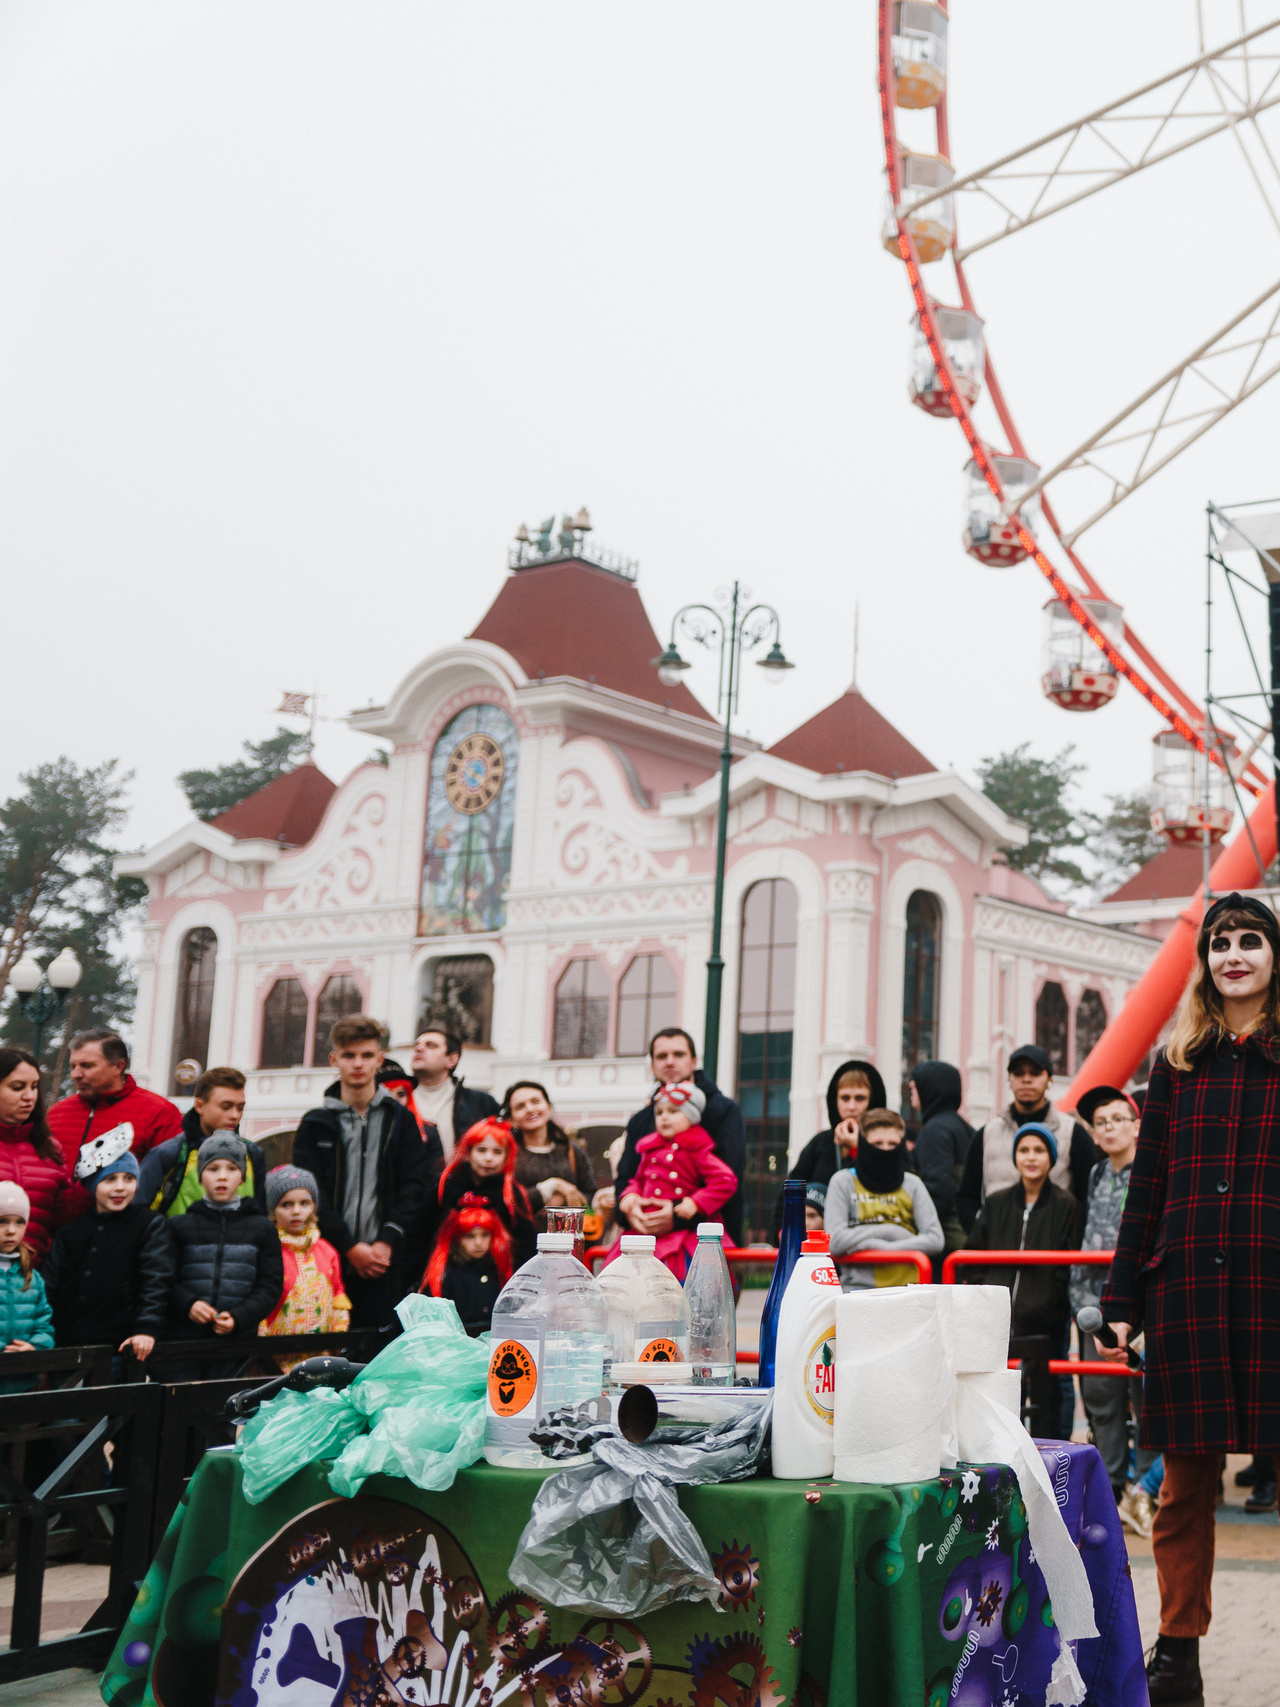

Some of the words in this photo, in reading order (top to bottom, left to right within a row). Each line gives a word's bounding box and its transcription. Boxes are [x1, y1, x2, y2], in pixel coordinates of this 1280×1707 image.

[491, 1353, 501, 1375] MAD
[502, 1344, 514, 1354] SCI
[516, 1349, 531, 1376] SHOW
[652, 1343, 665, 1352] SCI
[815, 1363, 835, 1394] FAI
